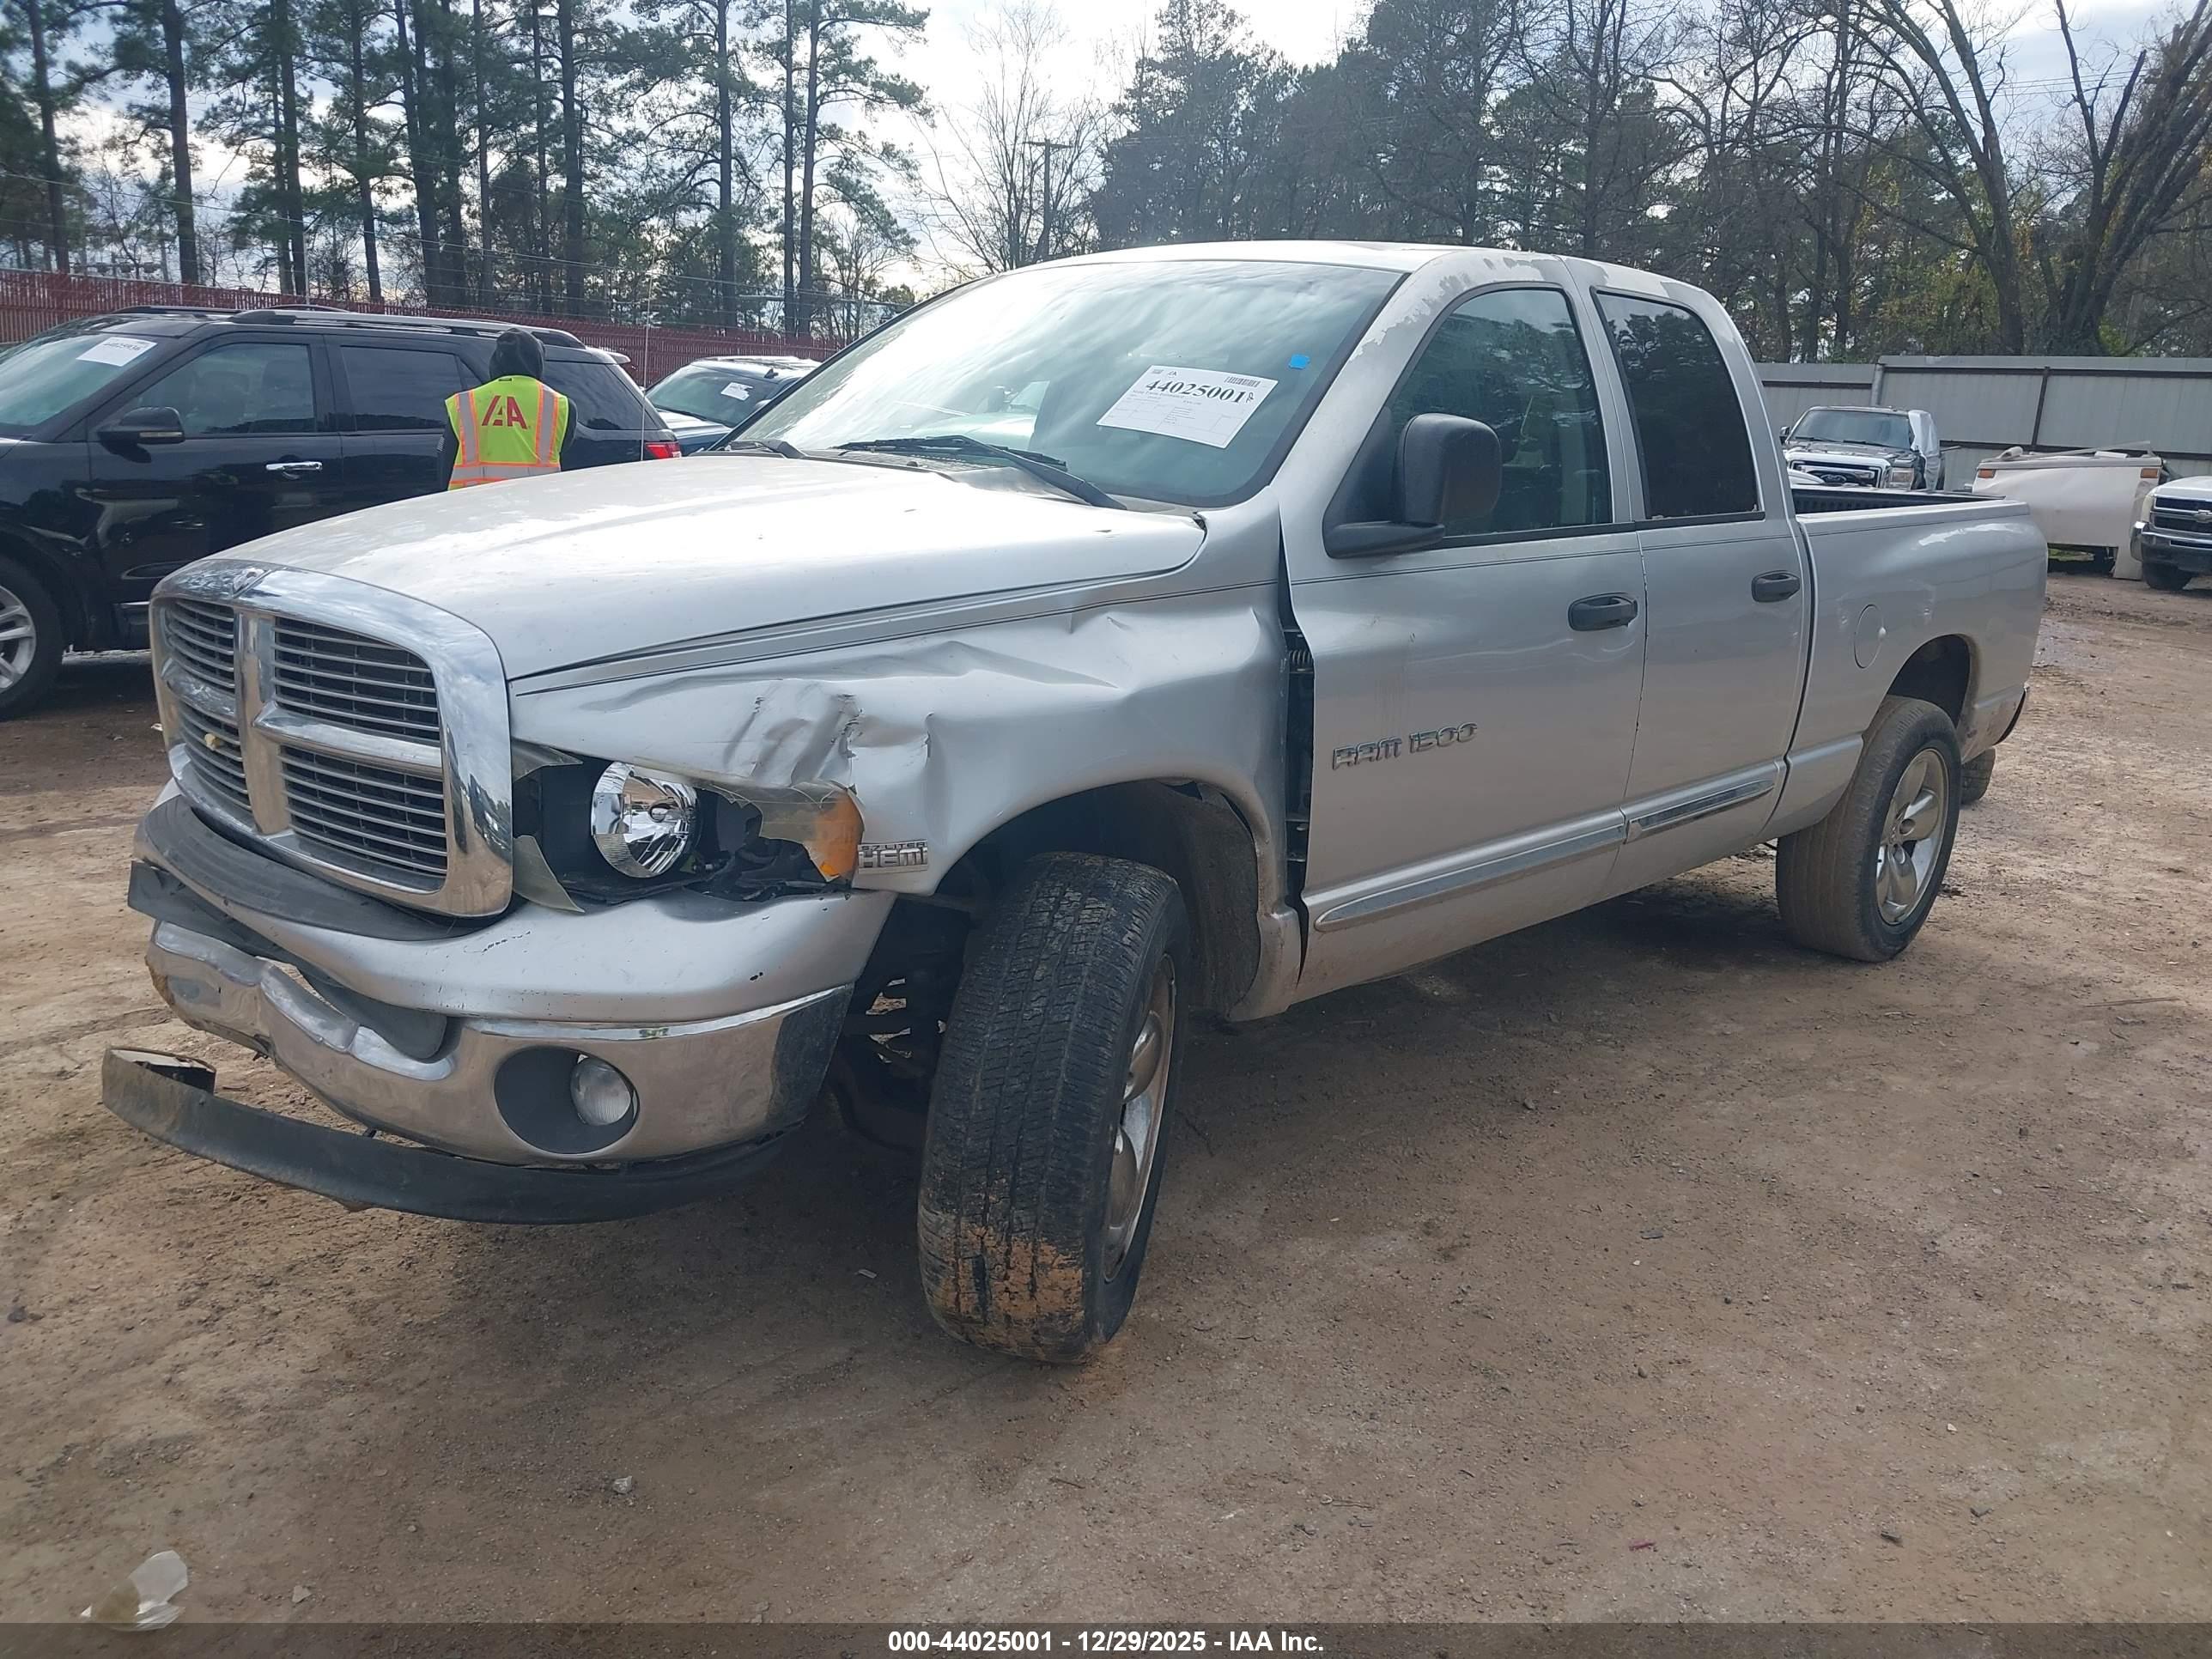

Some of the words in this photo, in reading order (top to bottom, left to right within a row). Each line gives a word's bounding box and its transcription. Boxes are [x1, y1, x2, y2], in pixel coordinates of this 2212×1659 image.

[1146, 380, 1246, 403] 44025001
[1333, 736, 1402, 770] RAM
[1409, 721, 1478, 754] 1500
[884, 842, 925, 850] LITER
[858, 847, 928, 869] HEMI
